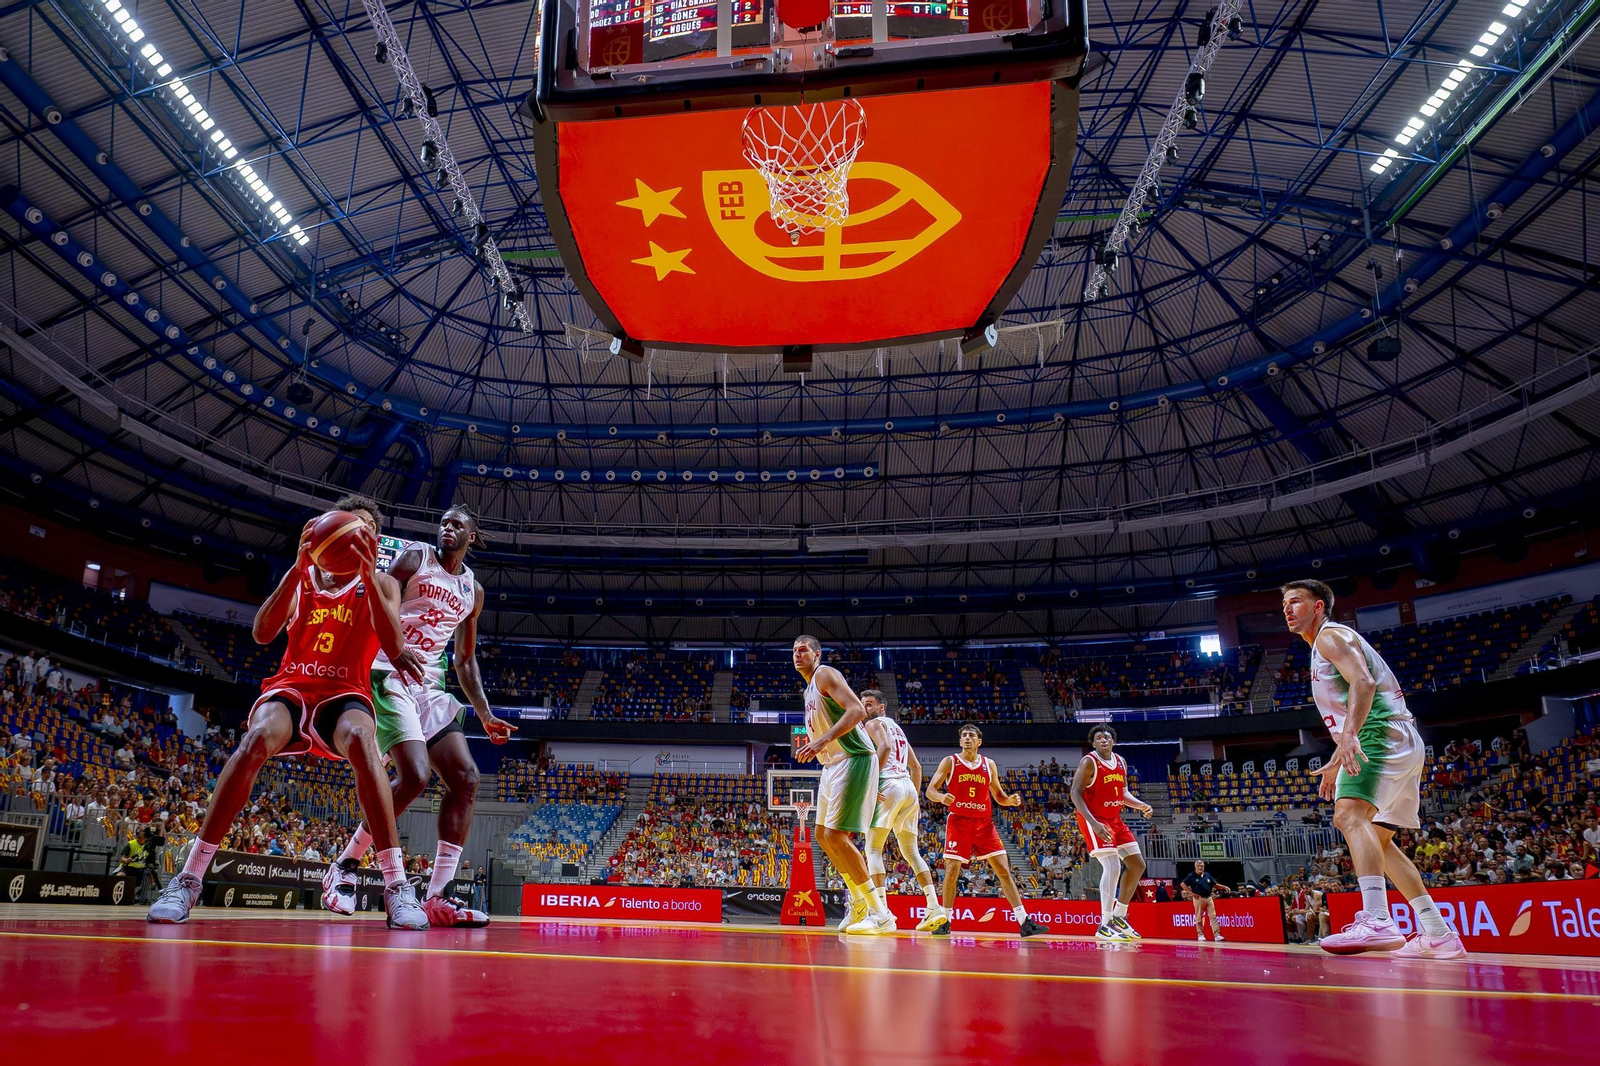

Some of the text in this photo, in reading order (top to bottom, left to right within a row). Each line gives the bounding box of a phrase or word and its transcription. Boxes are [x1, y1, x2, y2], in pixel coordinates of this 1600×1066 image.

[734, 2, 739, 11] F
[745, 2, 751, 10] 2
[655, 17, 663, 25] 16
[734, 14, 739, 23] F
[744, 14, 751, 22] 2
[654, 28, 663, 36] 17
[718, 181, 745, 220] FEB
[384, 538, 395, 547] 28
[305, 604, 353, 626] ESPAÑA
[312, 632, 335, 654] 13
[284, 661, 349, 679] endesa
[958, 773, 986, 785] ESPAÑA
[1103, 773, 1125, 784] ESPAÑA
[968, 786, 976, 798] 5
[1114, 786, 1119, 797] 1
[955, 801, 987, 810] endesa
[237, 862, 266, 876] endesa
[40, 883, 100, 898] #LaFamilia
[747, 890, 781, 901] endesa
[540, 894, 702, 911] IBERIA Talento a bordo
[787, 908, 819, 917] CaixaBank
[1054, 913, 1062, 924] a
[1064, 911, 1102, 925] bordo
[1231, 916, 1236, 927] a
[1235, 912, 1255, 928] bordo
